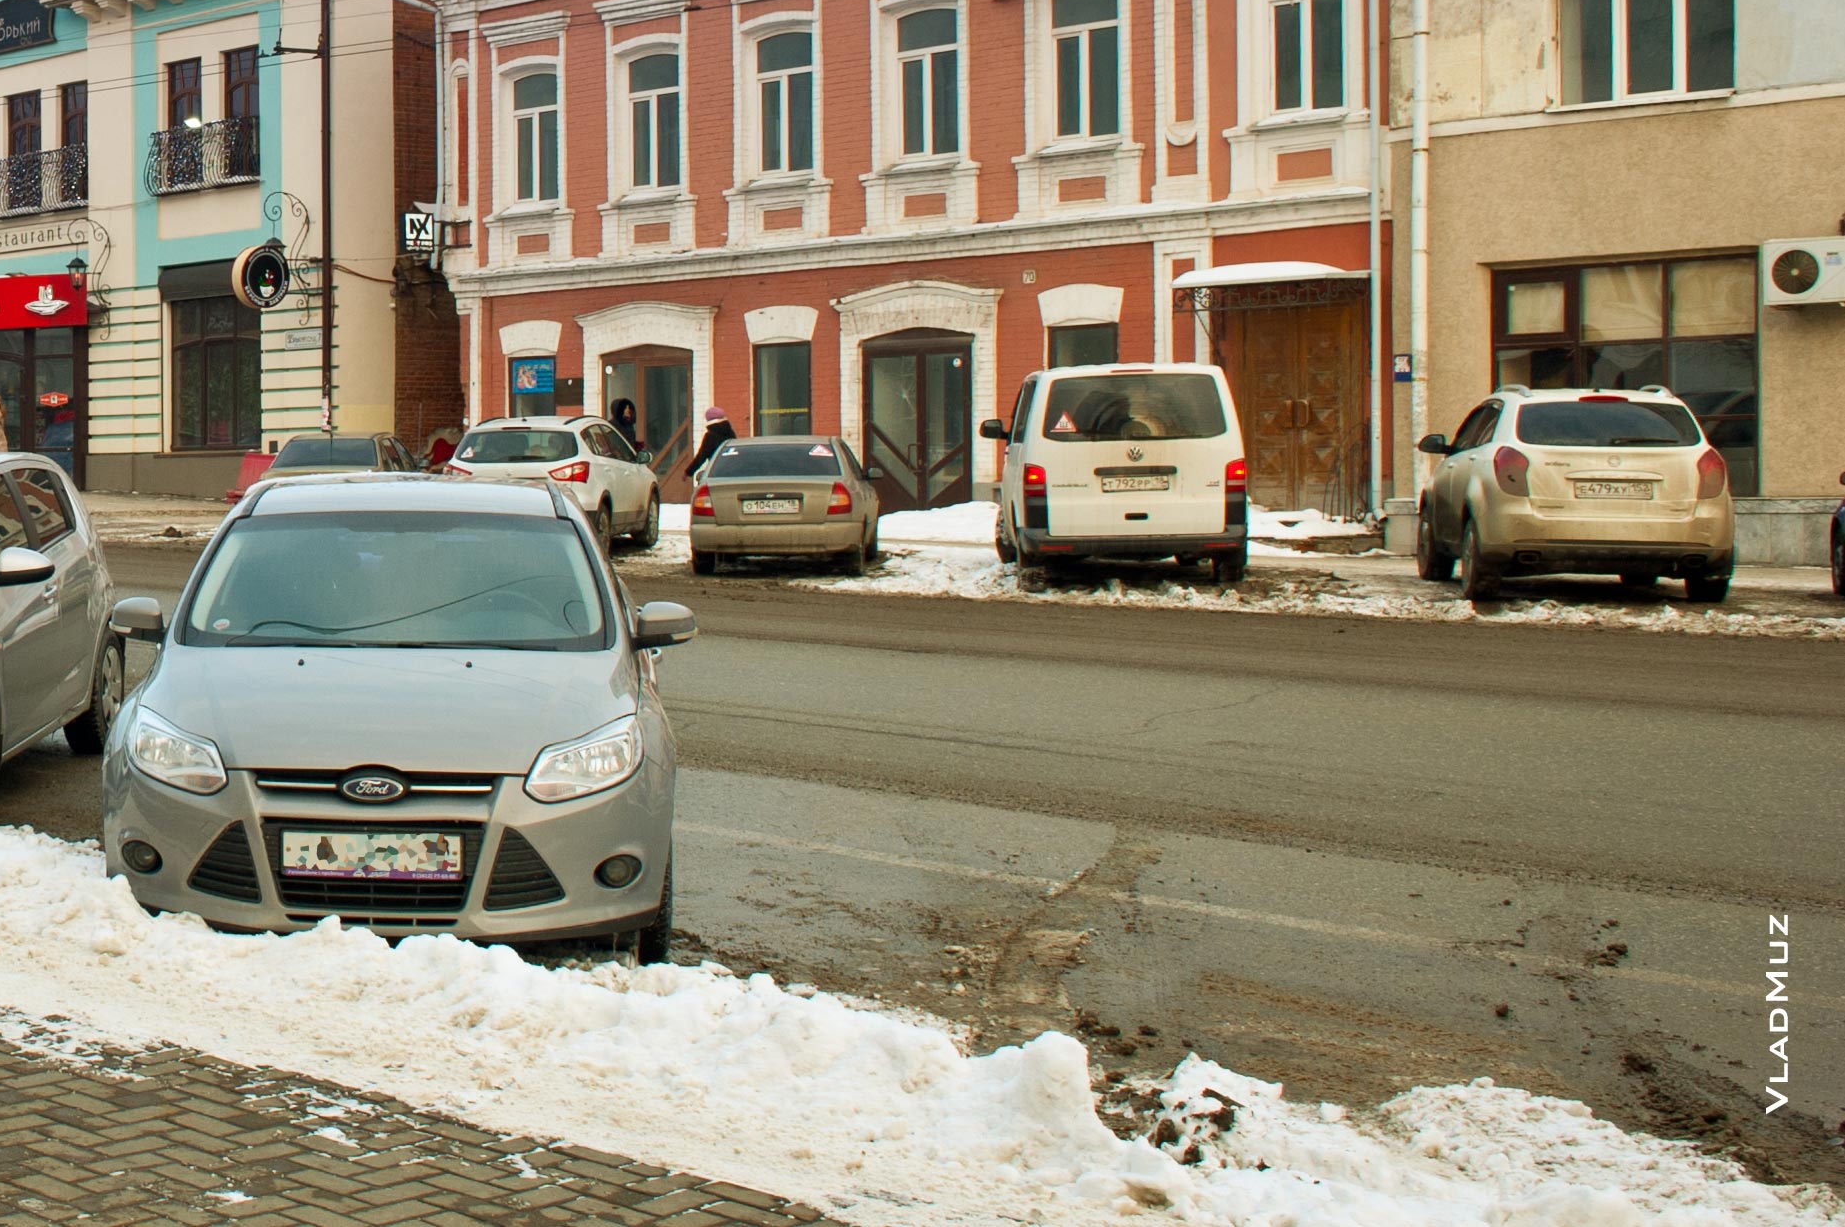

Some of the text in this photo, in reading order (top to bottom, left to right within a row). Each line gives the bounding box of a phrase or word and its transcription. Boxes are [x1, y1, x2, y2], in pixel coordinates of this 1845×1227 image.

[1025, 271, 1035, 282] 70
[1580, 483, 1649, 494] Е479ХУ 152
[746, 500, 784, 510] О104ЕН
[356, 779, 389, 794] Ford
